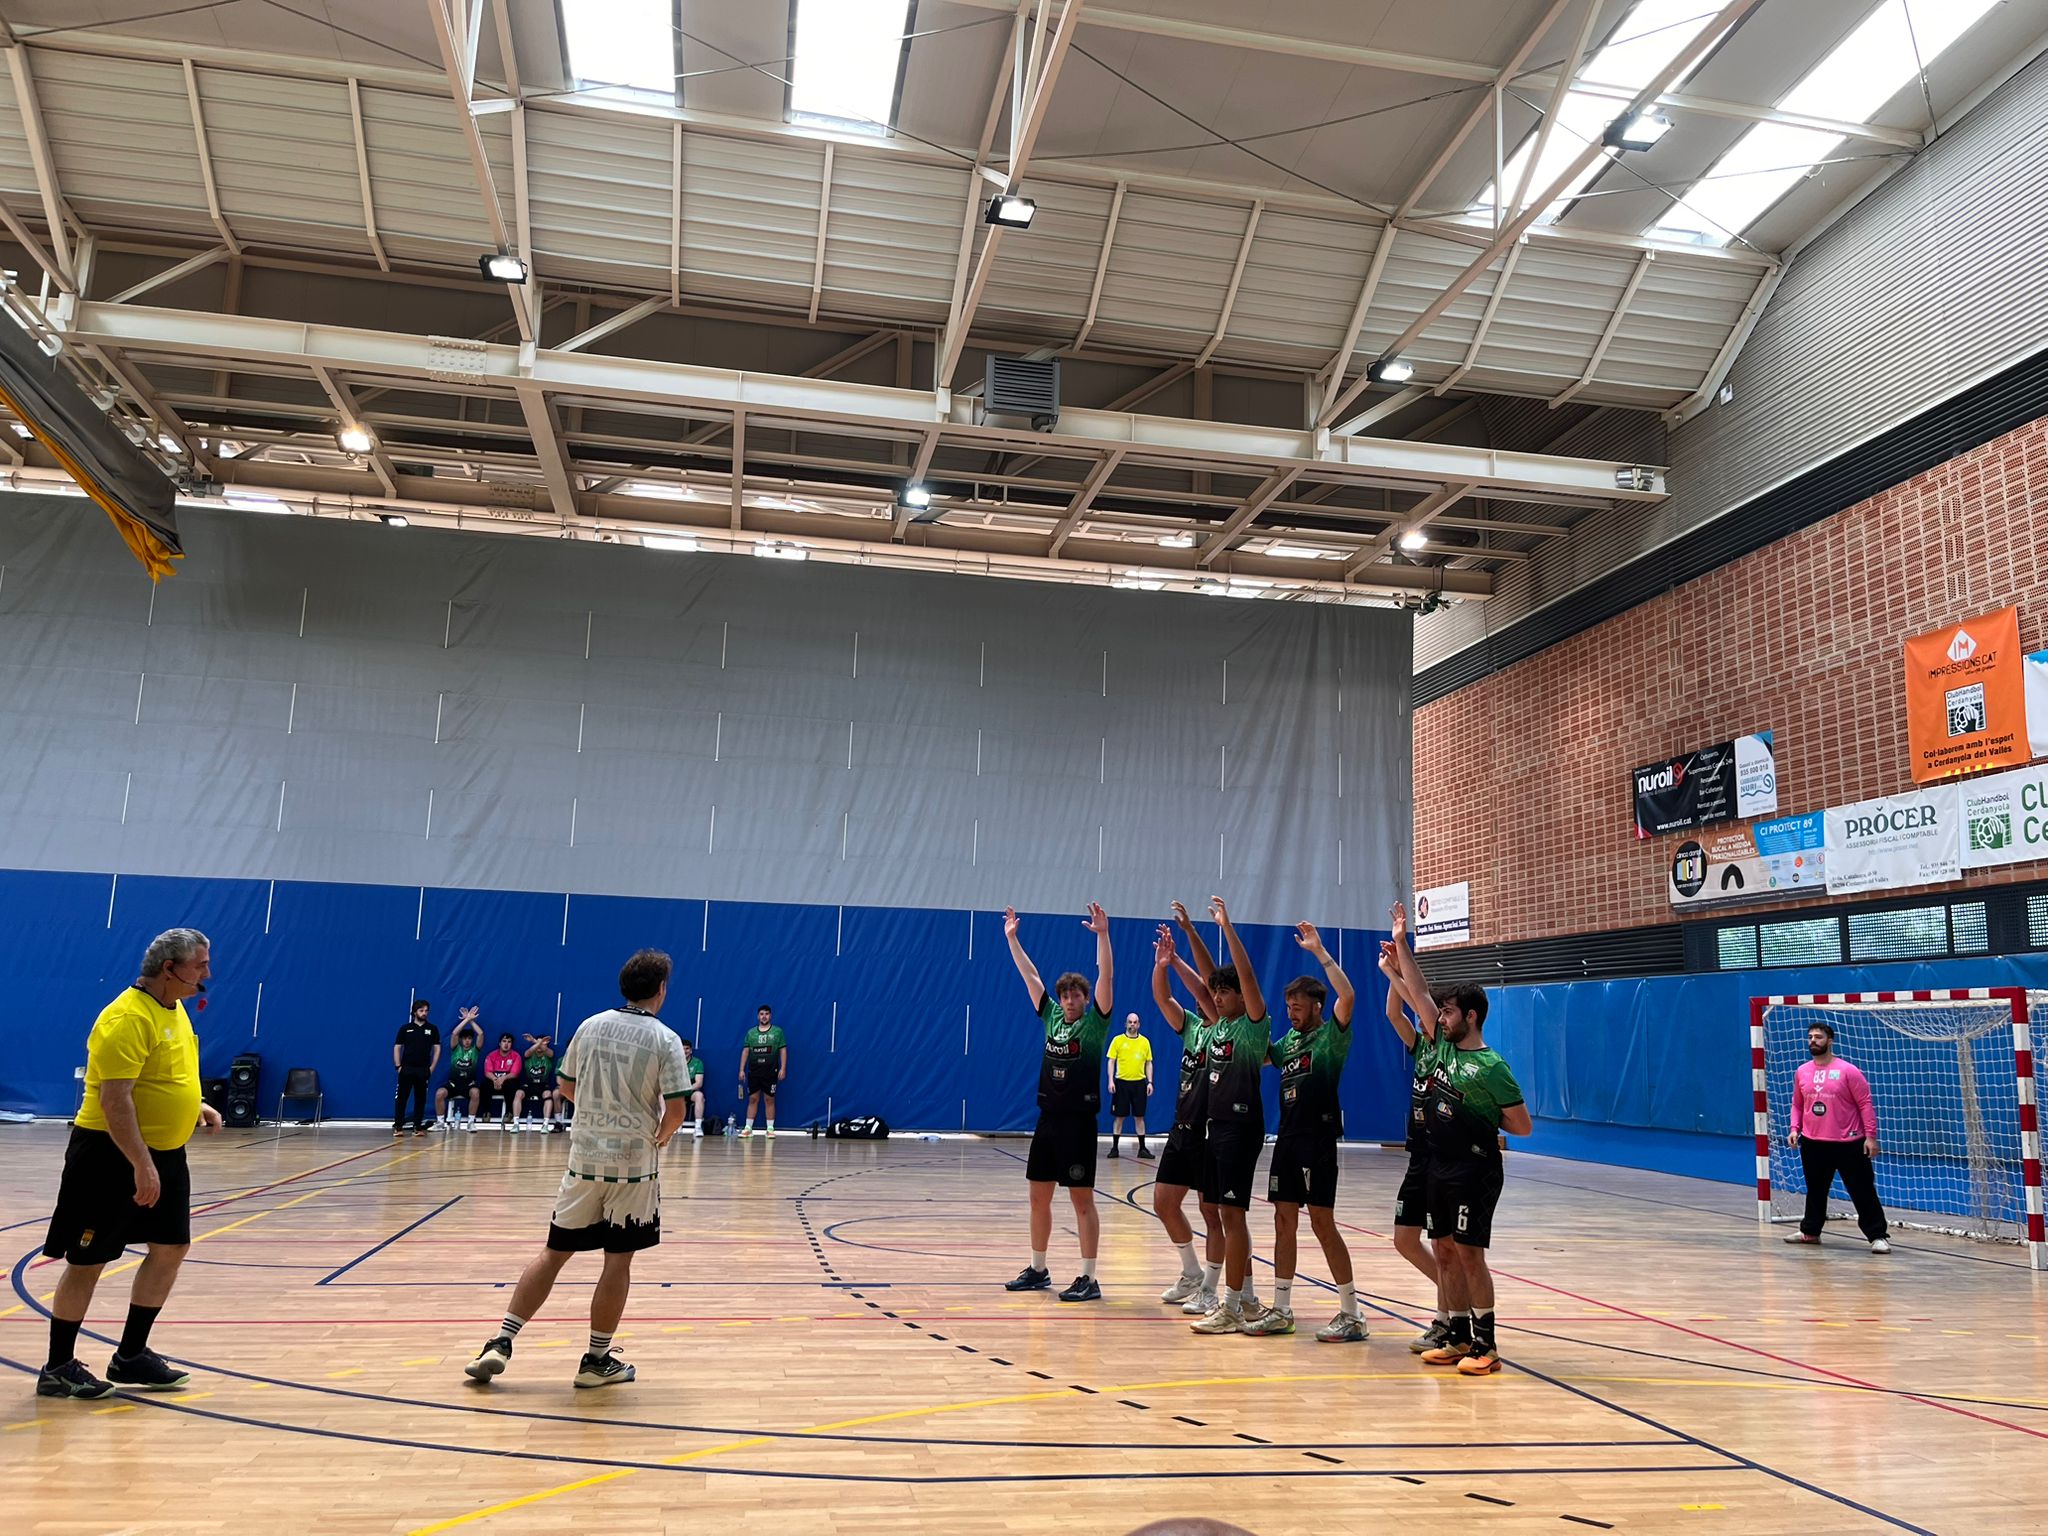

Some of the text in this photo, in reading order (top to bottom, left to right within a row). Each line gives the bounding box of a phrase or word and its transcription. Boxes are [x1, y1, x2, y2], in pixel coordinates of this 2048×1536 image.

[1966, 740, 1983, 750] amb
[1934, 753, 1972, 768] Cerdanyola
[1974, 749, 1987, 759] del
[1638, 765, 1673, 794] nuroil
[1967, 793, 2009, 807] ClubHandbol
[1967, 802, 2009, 817] Cerdanyola
[1657, 817, 1692, 830] www.nuroil.cat
[1769, 820, 1801, 834] PROTECT
[1803, 818, 1813, 828] 89
[1902, 829, 1938, 841] COMPTABLE
[1813, 1070, 1826, 1083] 83
